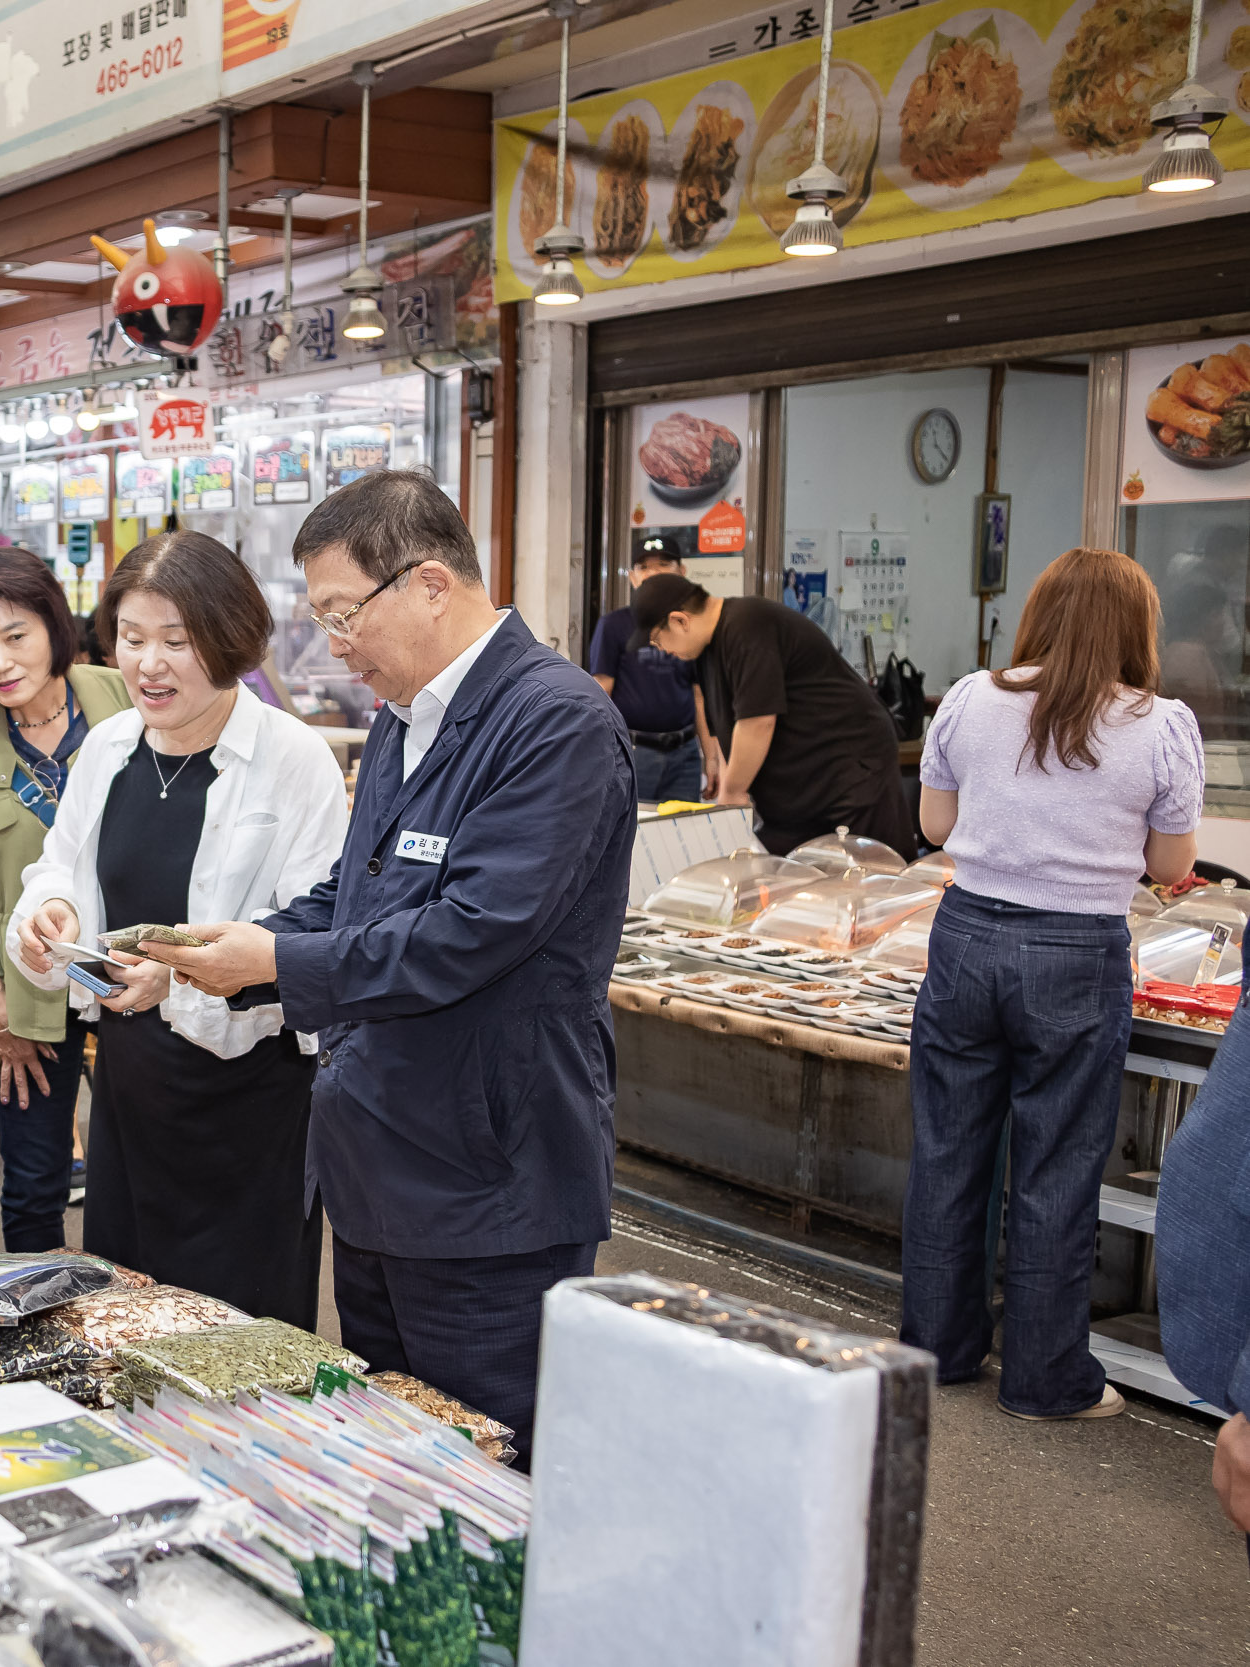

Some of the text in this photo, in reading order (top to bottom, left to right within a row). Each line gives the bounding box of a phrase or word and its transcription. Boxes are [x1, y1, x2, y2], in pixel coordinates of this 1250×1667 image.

[62, 30, 92, 67] 포장
[100, 20, 113, 52] 및
[96, 36, 184, 96] 466-6012
